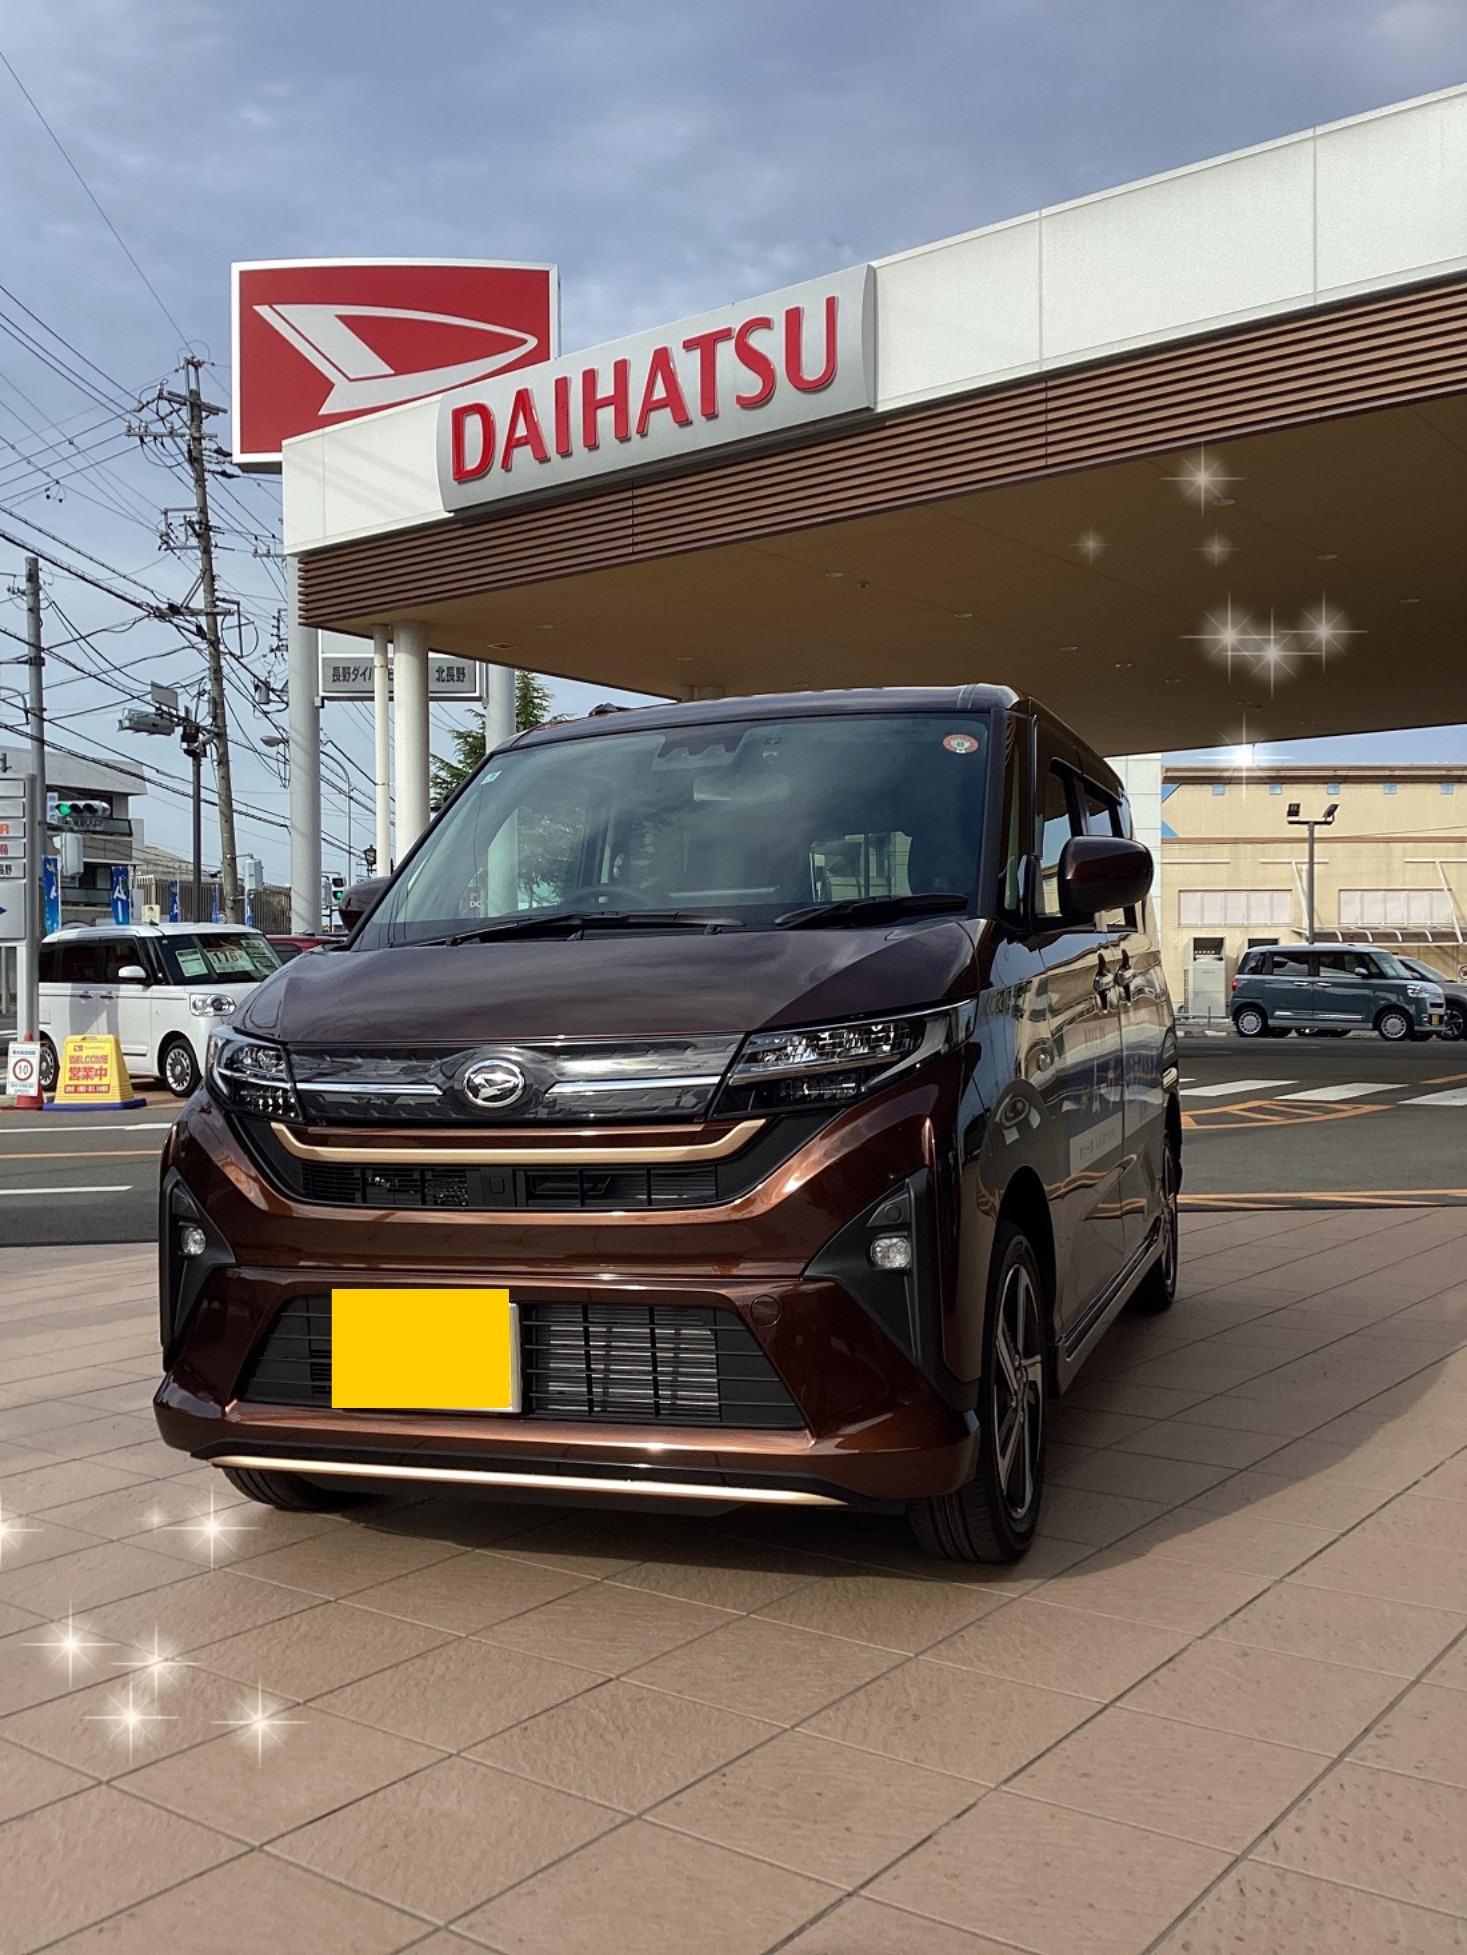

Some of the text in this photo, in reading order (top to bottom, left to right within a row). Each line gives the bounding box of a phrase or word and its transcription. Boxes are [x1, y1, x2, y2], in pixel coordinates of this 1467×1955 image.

[452, 295, 838, 483] DAIHATSU
[435, 666, 466, 683] 北長野
[18, 1064, 29, 1075] 10
[69, 1066, 107, 1081] 営業中
